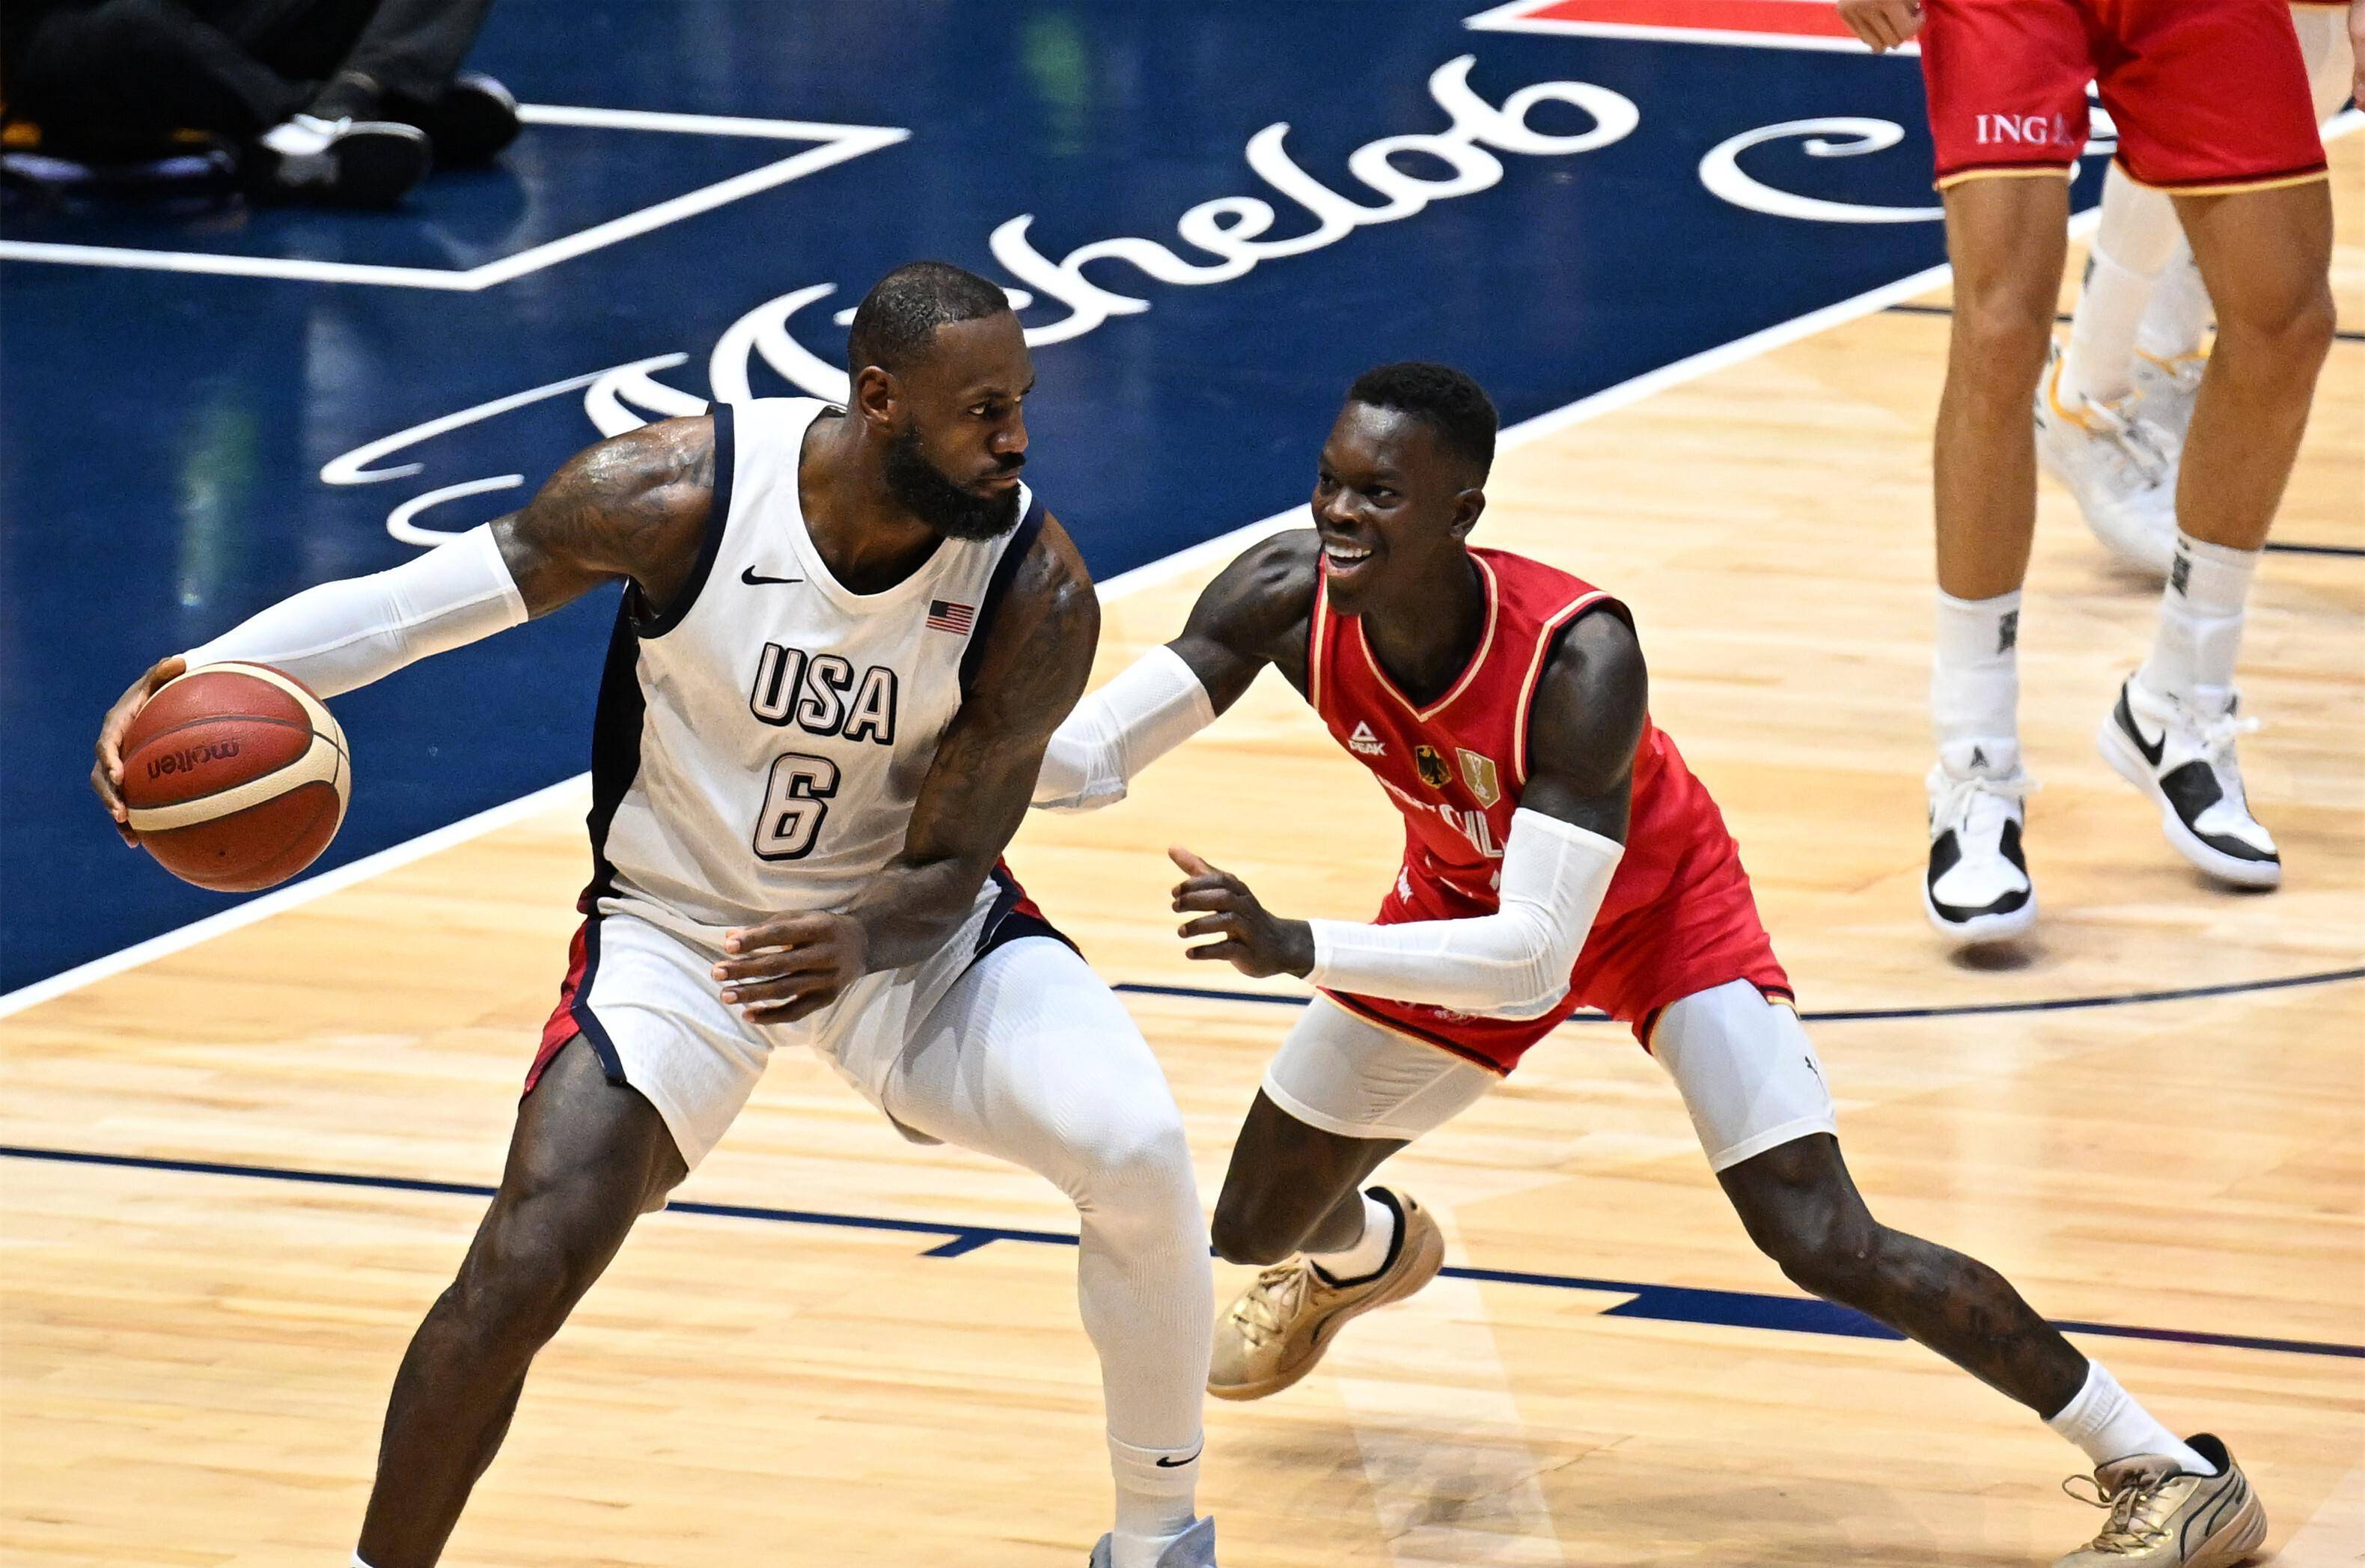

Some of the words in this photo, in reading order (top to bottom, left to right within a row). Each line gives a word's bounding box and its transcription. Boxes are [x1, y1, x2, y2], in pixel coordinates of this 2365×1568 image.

[1976, 113, 2048, 145] ING
[750, 641, 898, 746] USA
[147, 737, 240, 779] molten
[753, 751, 842, 861] 6
